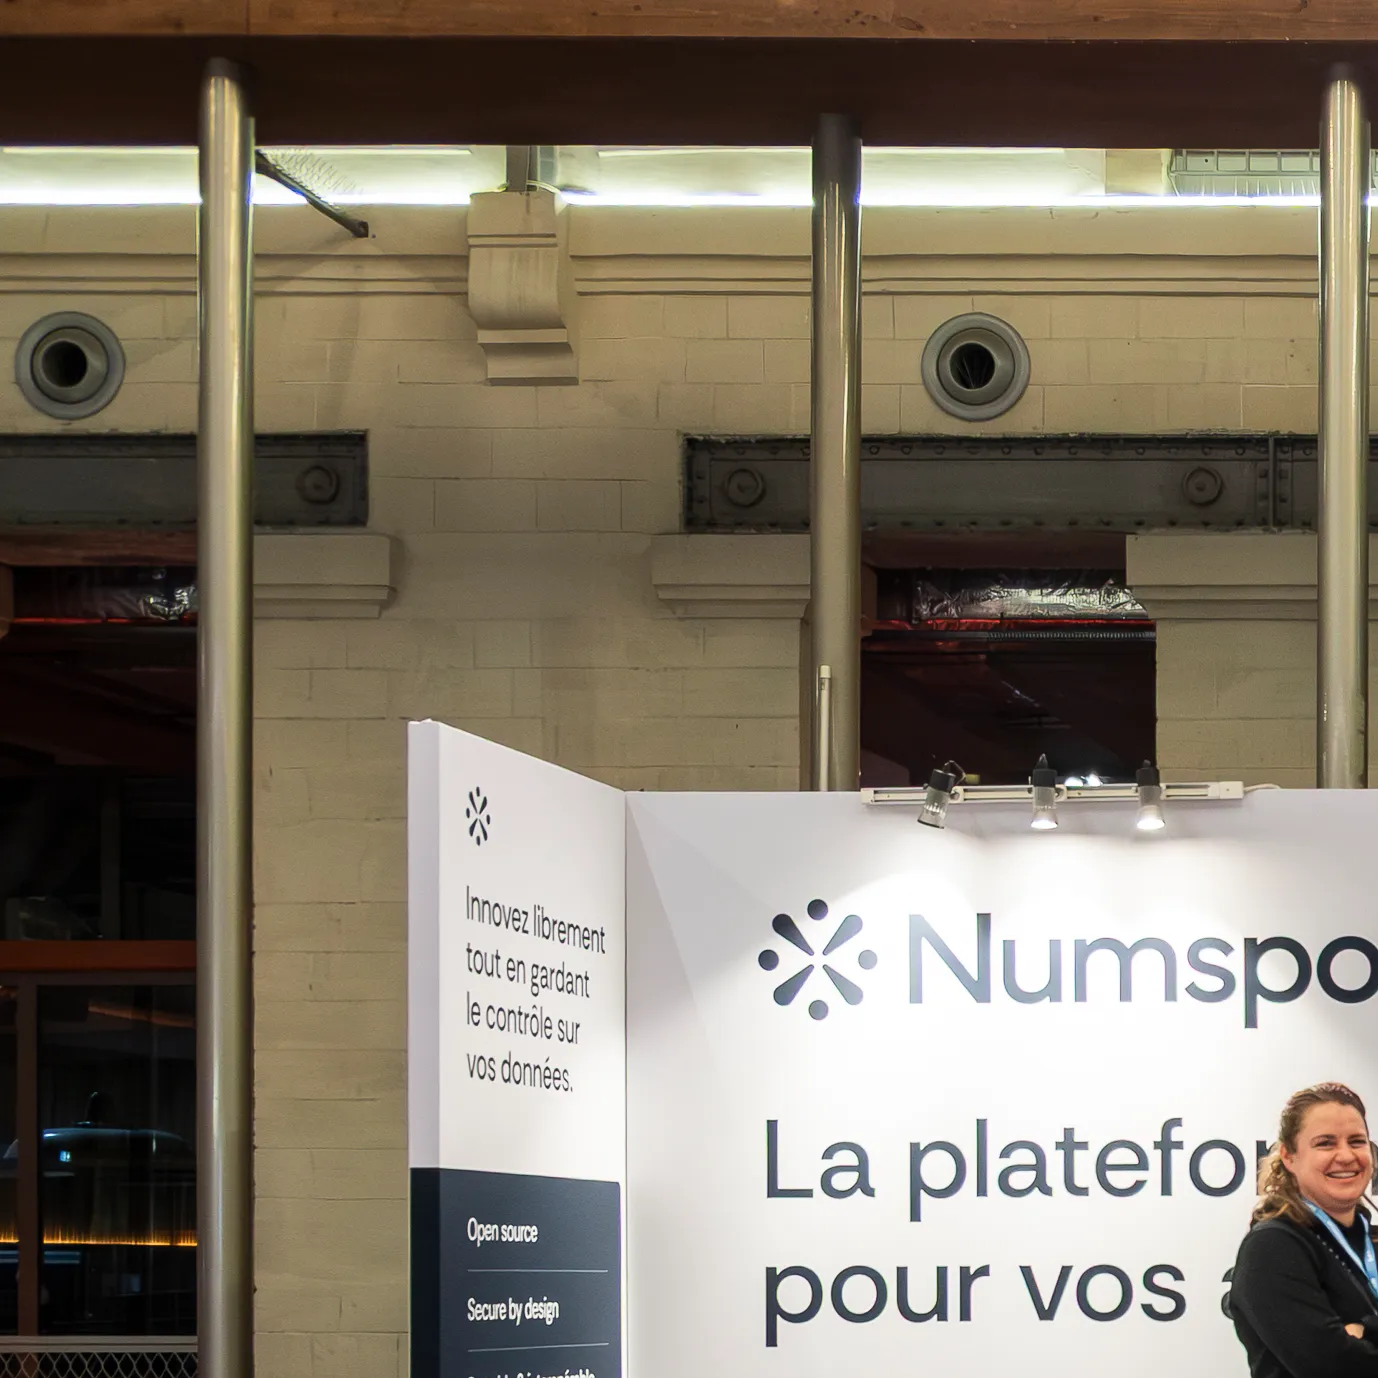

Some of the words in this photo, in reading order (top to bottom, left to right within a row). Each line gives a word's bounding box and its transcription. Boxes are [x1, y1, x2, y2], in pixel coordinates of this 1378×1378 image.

[466, 886, 529, 936] Innovez
[532, 904, 606, 954] librement
[466, 943, 502, 980] tout
[506, 957, 526, 984] en
[531, 961, 590, 998] gardant
[466, 991, 481, 1027] le
[485, 1004, 553, 1040] contrôle
[557, 1018, 581, 1045] sur
[466, 1053, 496, 1082] vos
[500, 1052, 573, 1093] données.
[766, 1119, 876, 1200] La
[467, 1217, 499, 1248] Open
[500, 1223, 539, 1244] source
[467, 1297, 507, 1322] Secure
[508, 1297, 524, 1326] by
[524, 1296, 560, 1326] design
[765, 1264, 991, 1348] pour
[1018, 1263, 1187, 1323] vos
